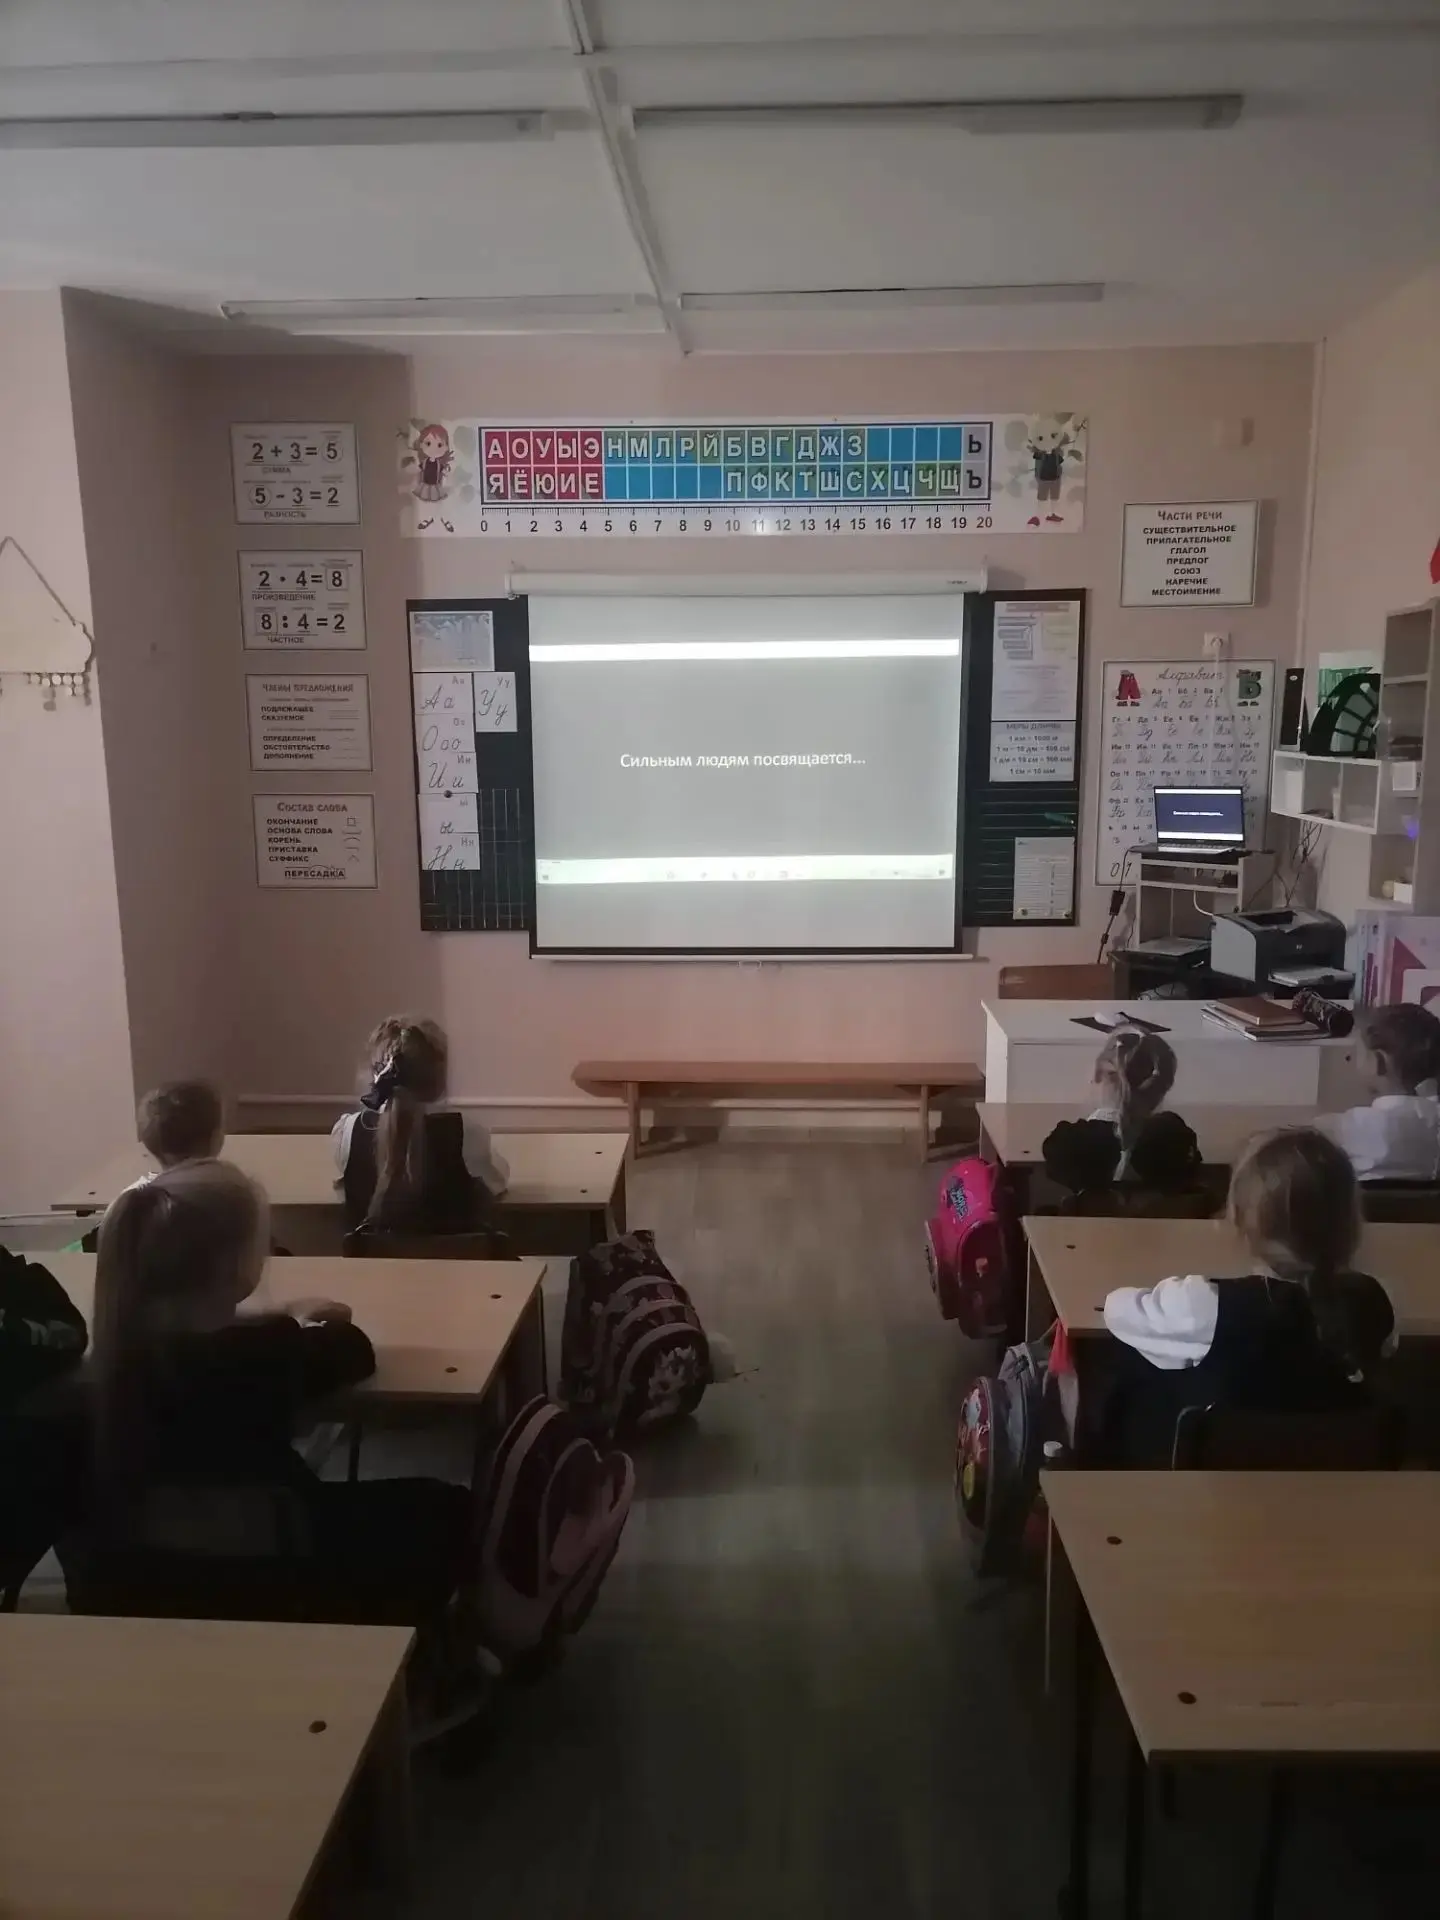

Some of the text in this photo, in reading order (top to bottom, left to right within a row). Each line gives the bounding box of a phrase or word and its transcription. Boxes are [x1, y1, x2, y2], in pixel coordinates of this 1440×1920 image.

[252, 443, 337, 459] 2 + 3 = 5
[488, 434, 982, 460] А О У Ы Э Н М Л Р Й Б В Г Д Ж З Ь
[489, 469, 982, 495] Я Ё Ю И Е П Ф К Т Ш С Х Ц Ч Щ Ъ
[255, 487, 266, 504] 5
[292, 487, 303, 504] 3
[310, 491, 321, 500] =
[327, 487, 339, 503] 2
[481, 516, 992, 532] 0 1 2 3 4 5 6 7 8 9 10 11 12 13 14 15 16 17 18 19 20
[1143, 525, 1236, 534] СУЩЕСТВИТЕЛЬНОЕ
[1146, 536, 1231, 544] ПРИЛАГАТЕЛЬНОЕ
[1166, 557, 1209, 565] ПРЕДЛОГ
[259, 571, 270, 586] 2
[296, 571, 307, 587] 4
[311, 575, 323, 584] =
[332, 571, 342, 587] 8
[1152, 588, 1221, 596] МЕСТОИМЕНИЕ
[261, 613, 272, 629] 8
[297, 613, 308, 630] 4
[317, 618, 328, 626] =
[334, 613, 345, 629] 2
[268, 636, 304, 644] ЧАСТНОЕ
[620, 752, 866, 768] Сильным людям посвящается...
[284, 870, 345, 878] ПЕРЕСАДКА
